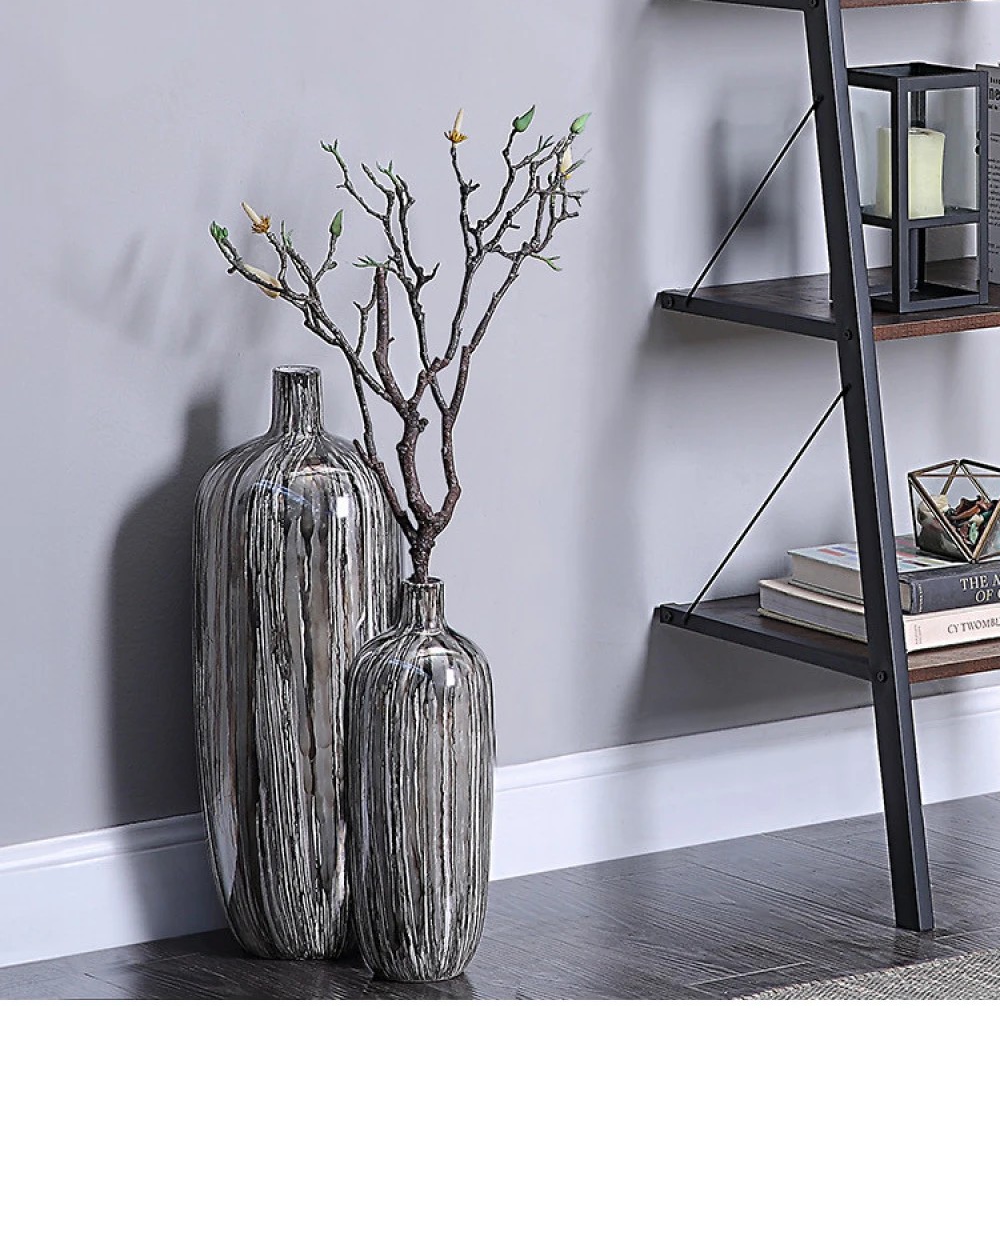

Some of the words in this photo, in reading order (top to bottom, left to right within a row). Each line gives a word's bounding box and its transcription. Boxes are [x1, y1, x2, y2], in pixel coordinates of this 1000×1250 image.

[960, 575, 989, 591] THE
[975, 590, 993, 603] OF
[947, 624, 960, 634] CY
